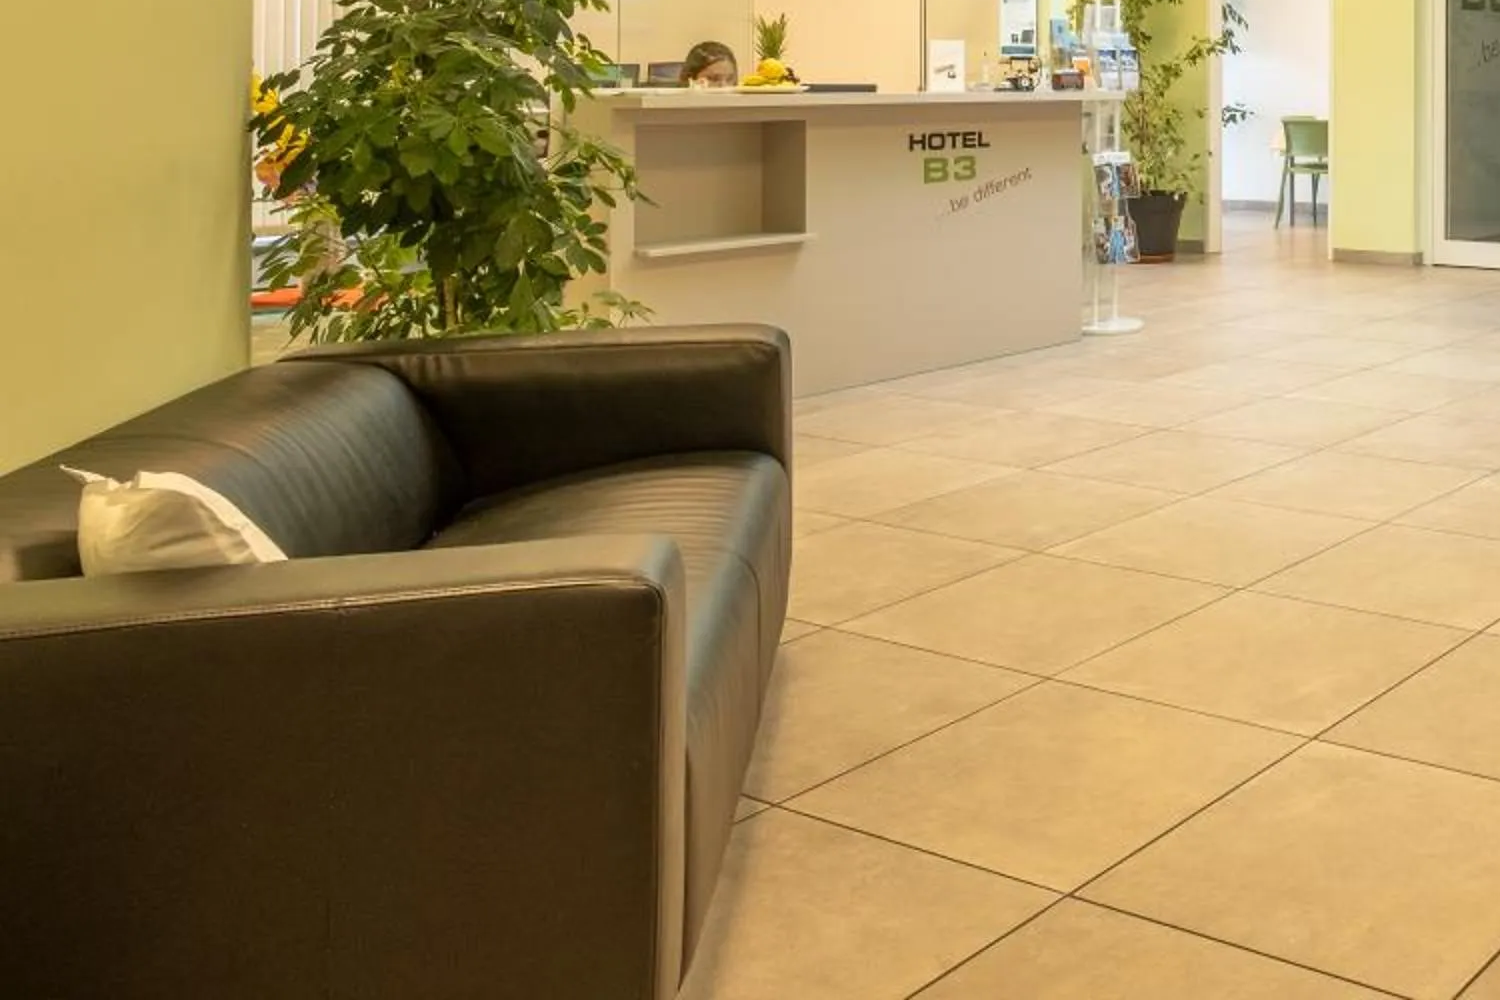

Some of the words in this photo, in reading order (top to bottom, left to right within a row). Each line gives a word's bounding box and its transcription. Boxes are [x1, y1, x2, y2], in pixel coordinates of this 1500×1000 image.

[908, 130, 991, 152] HOTEL
[923, 155, 977, 185] B3
[973, 167, 1032, 203] different
